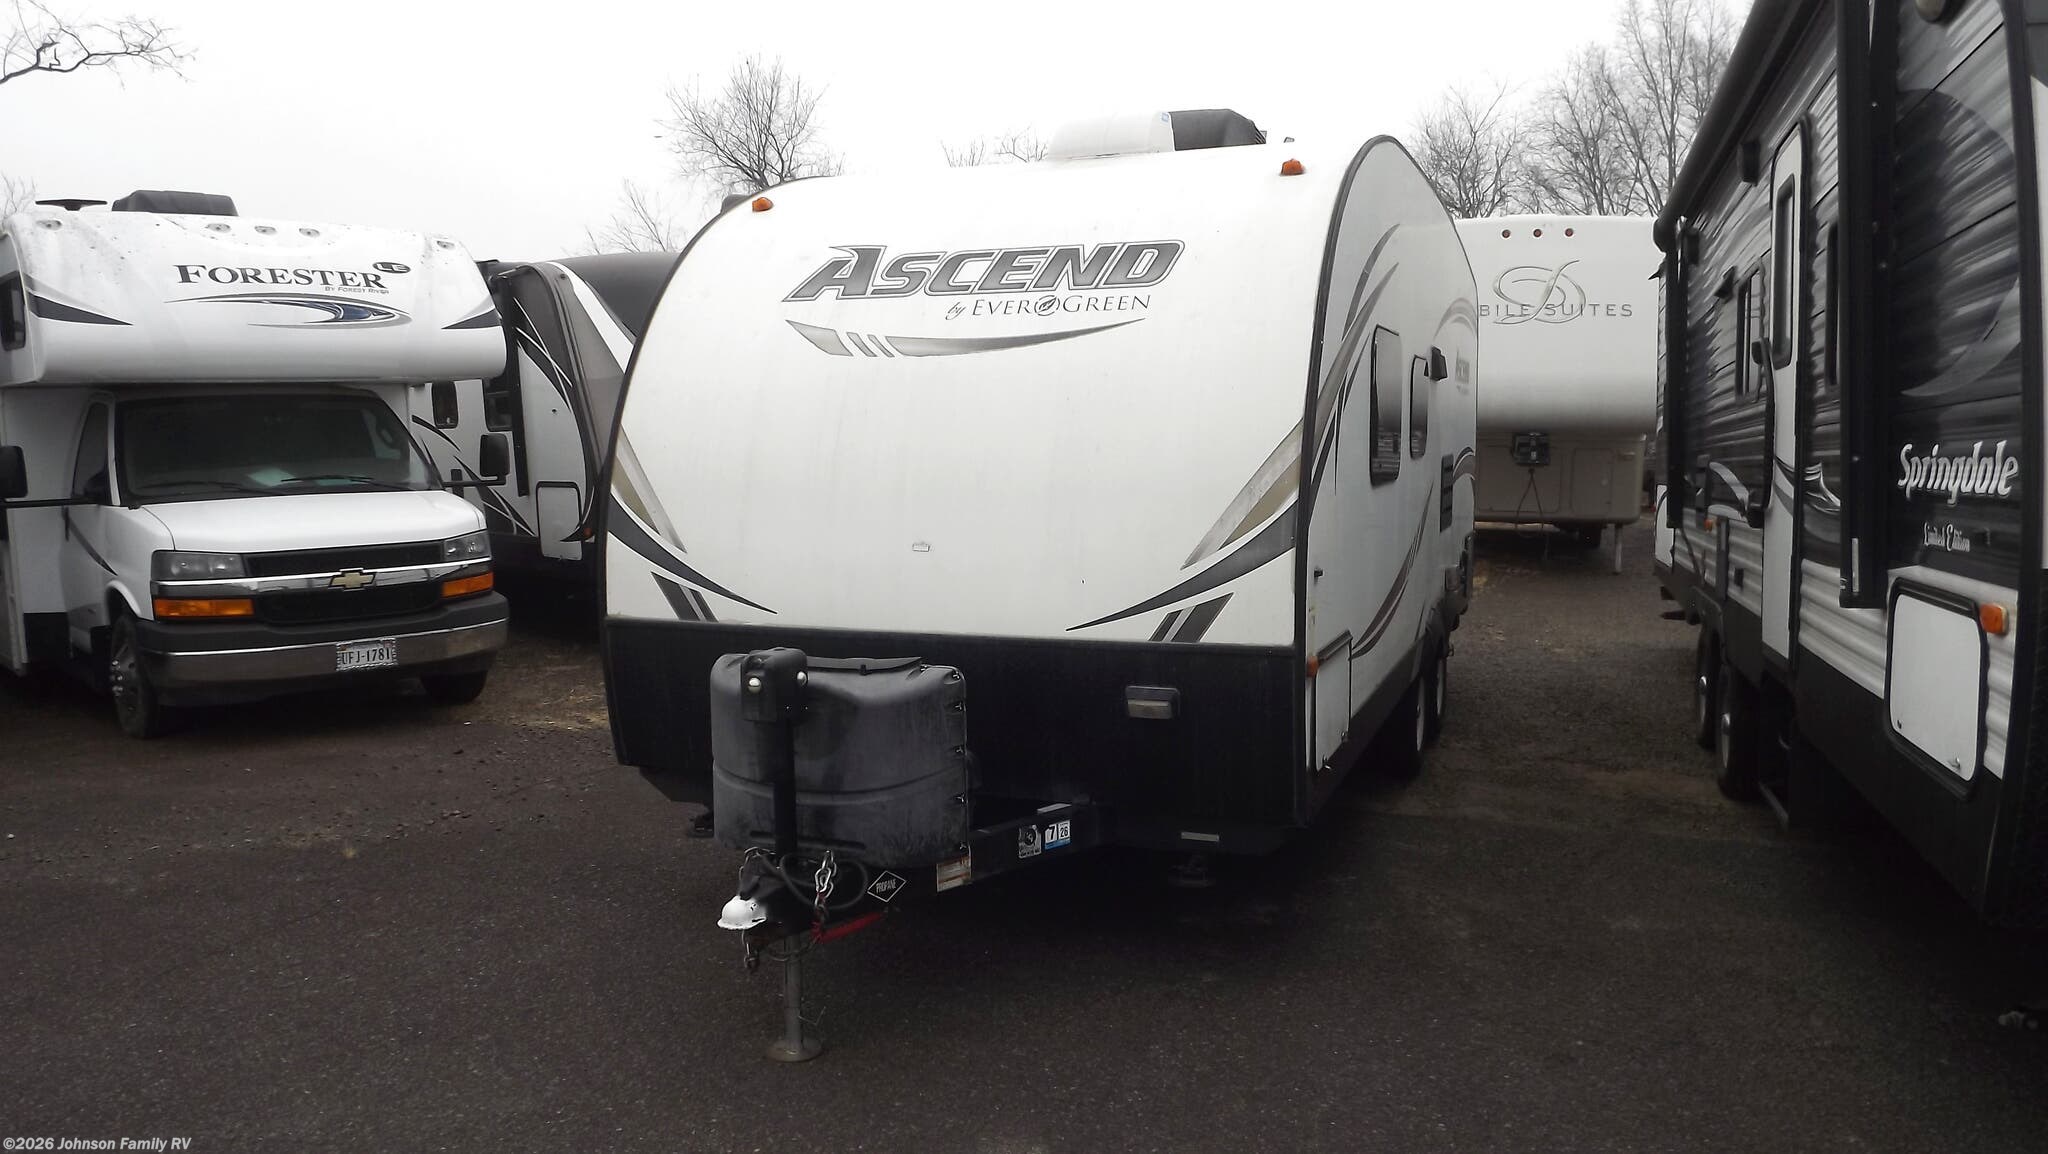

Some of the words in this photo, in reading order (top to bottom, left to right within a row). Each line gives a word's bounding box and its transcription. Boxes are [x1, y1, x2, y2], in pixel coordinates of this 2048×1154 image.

[173, 264, 388, 289] FORESTER
[782, 239, 1185, 303] ASCEND
[945, 301, 964, 321] by
[1479, 304, 1531, 317] BILE
[1544, 303, 1633, 317] SUITES
[1897, 440, 2019, 505] Springdale
